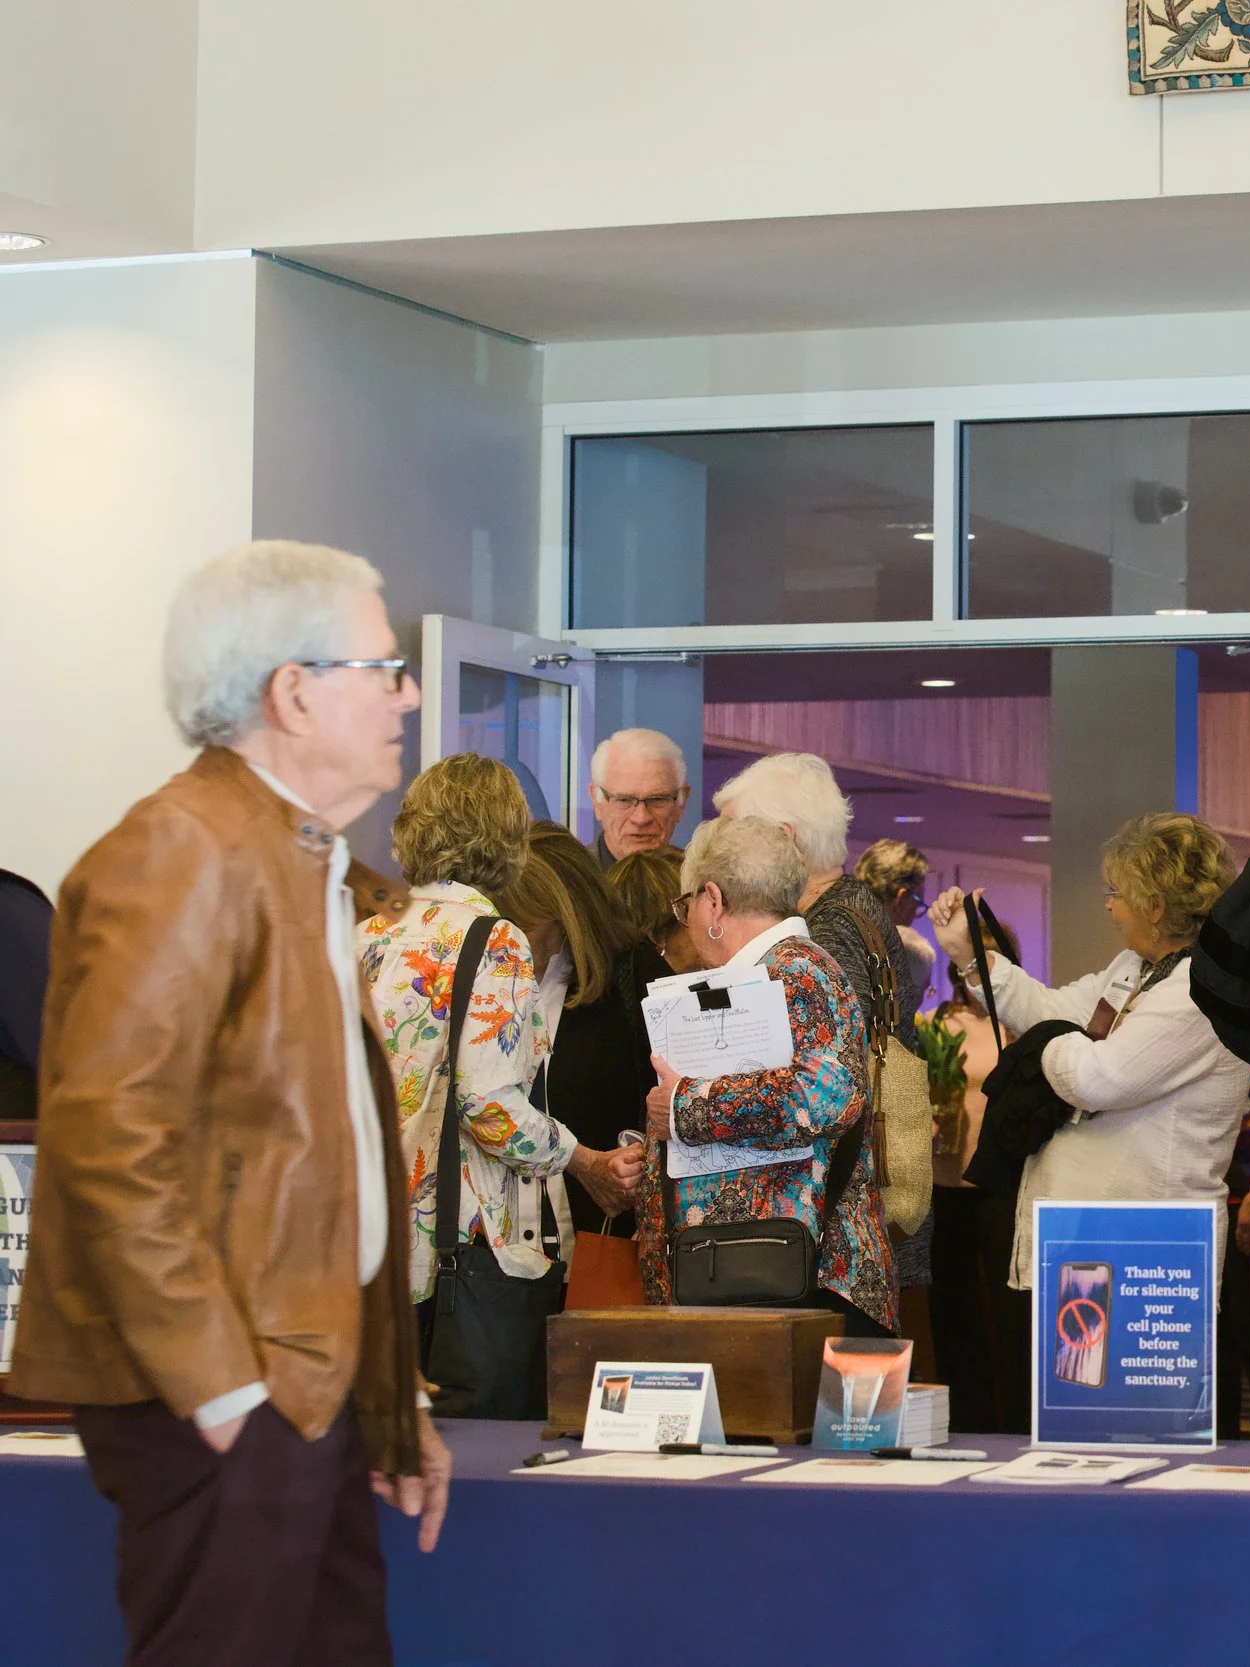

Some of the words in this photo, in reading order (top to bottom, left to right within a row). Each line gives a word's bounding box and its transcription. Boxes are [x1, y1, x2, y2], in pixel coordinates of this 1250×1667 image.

[1124, 1265, 1166, 1279] Thank
[1167, 1268, 1192, 1282] you
[1119, 1282, 1140, 1297] for
[1141, 1283, 1200, 1301] silencing
[1144, 1304, 1175, 1318] your
[1126, 1318, 1149, 1332] cell
[1151, 1319, 1192, 1335] phone
[1138, 1336, 1180, 1351] before
[1120, 1355, 1175, 1371] entering
[1176, 1355, 1198, 1368] the
[1125, 1374, 1191, 1389] sanctuary.
[830, 1423, 881, 1433] outpoured
